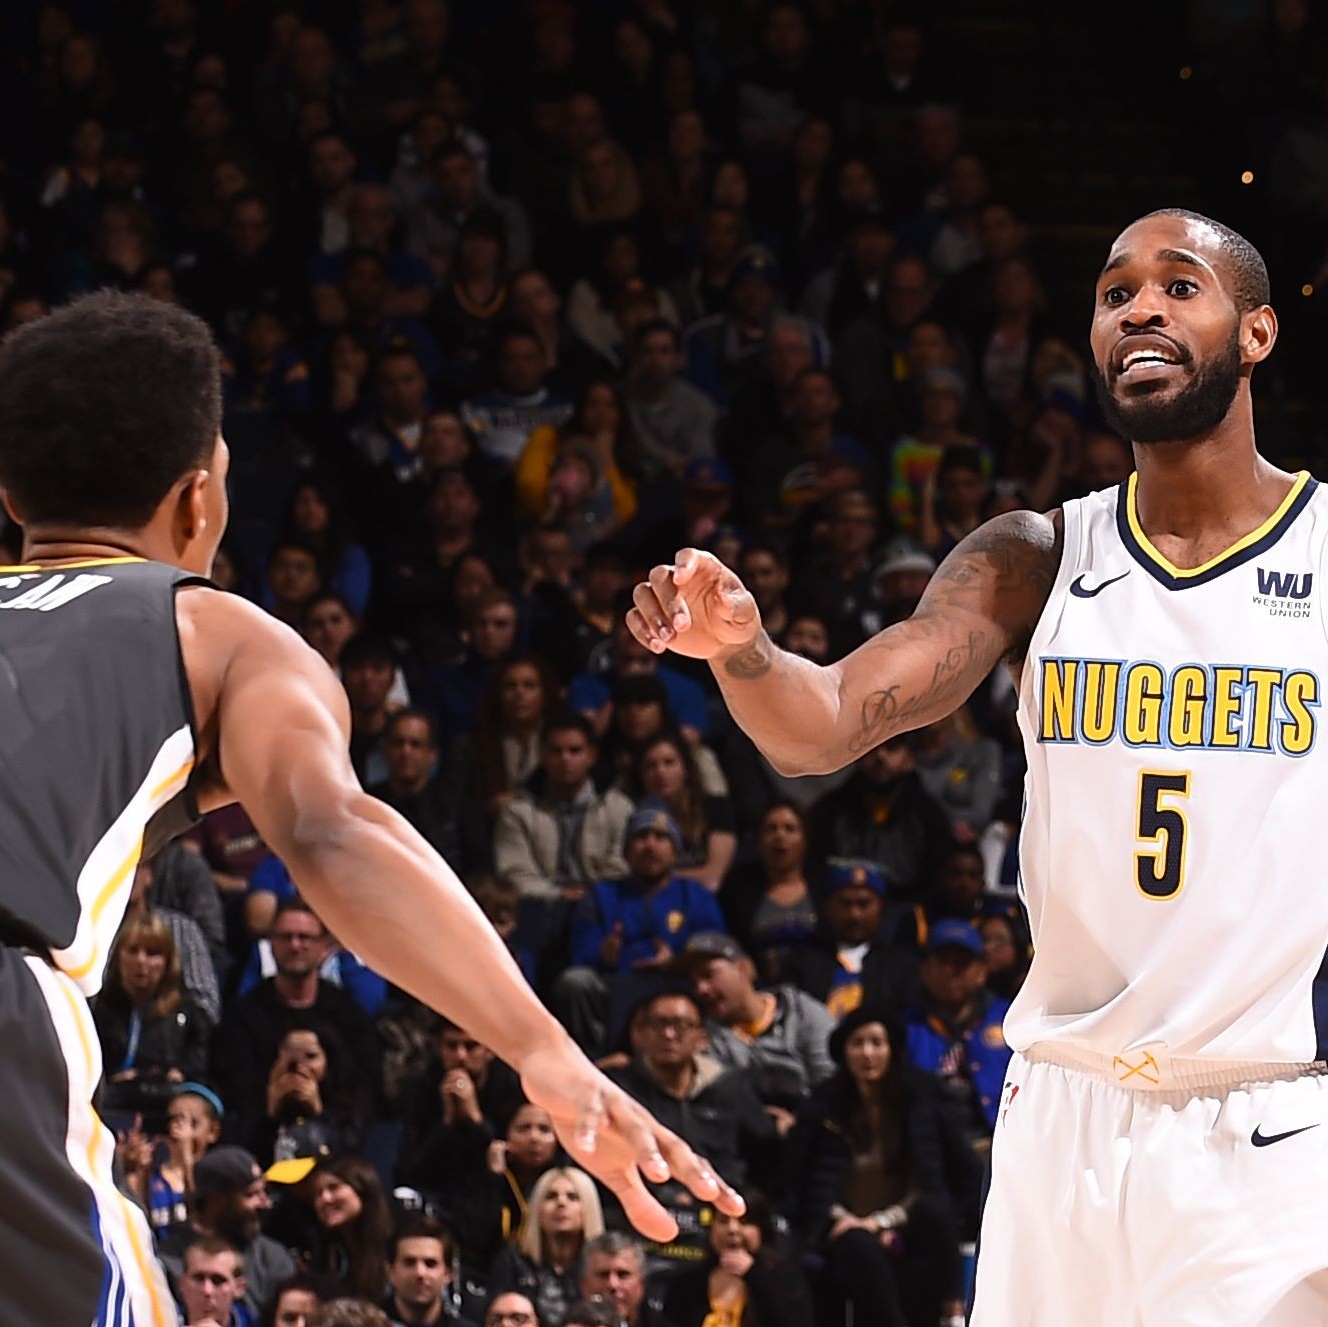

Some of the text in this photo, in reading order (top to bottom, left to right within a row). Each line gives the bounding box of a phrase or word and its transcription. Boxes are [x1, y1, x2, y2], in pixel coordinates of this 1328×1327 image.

[1256, 566, 1313, 599] WU
[1252, 596, 1312, 610] WESTERN
[1269, 608, 1311, 618] UNION
[1039, 657, 1321, 757] NUGGETS
[1133, 768, 1192, 901] 5
